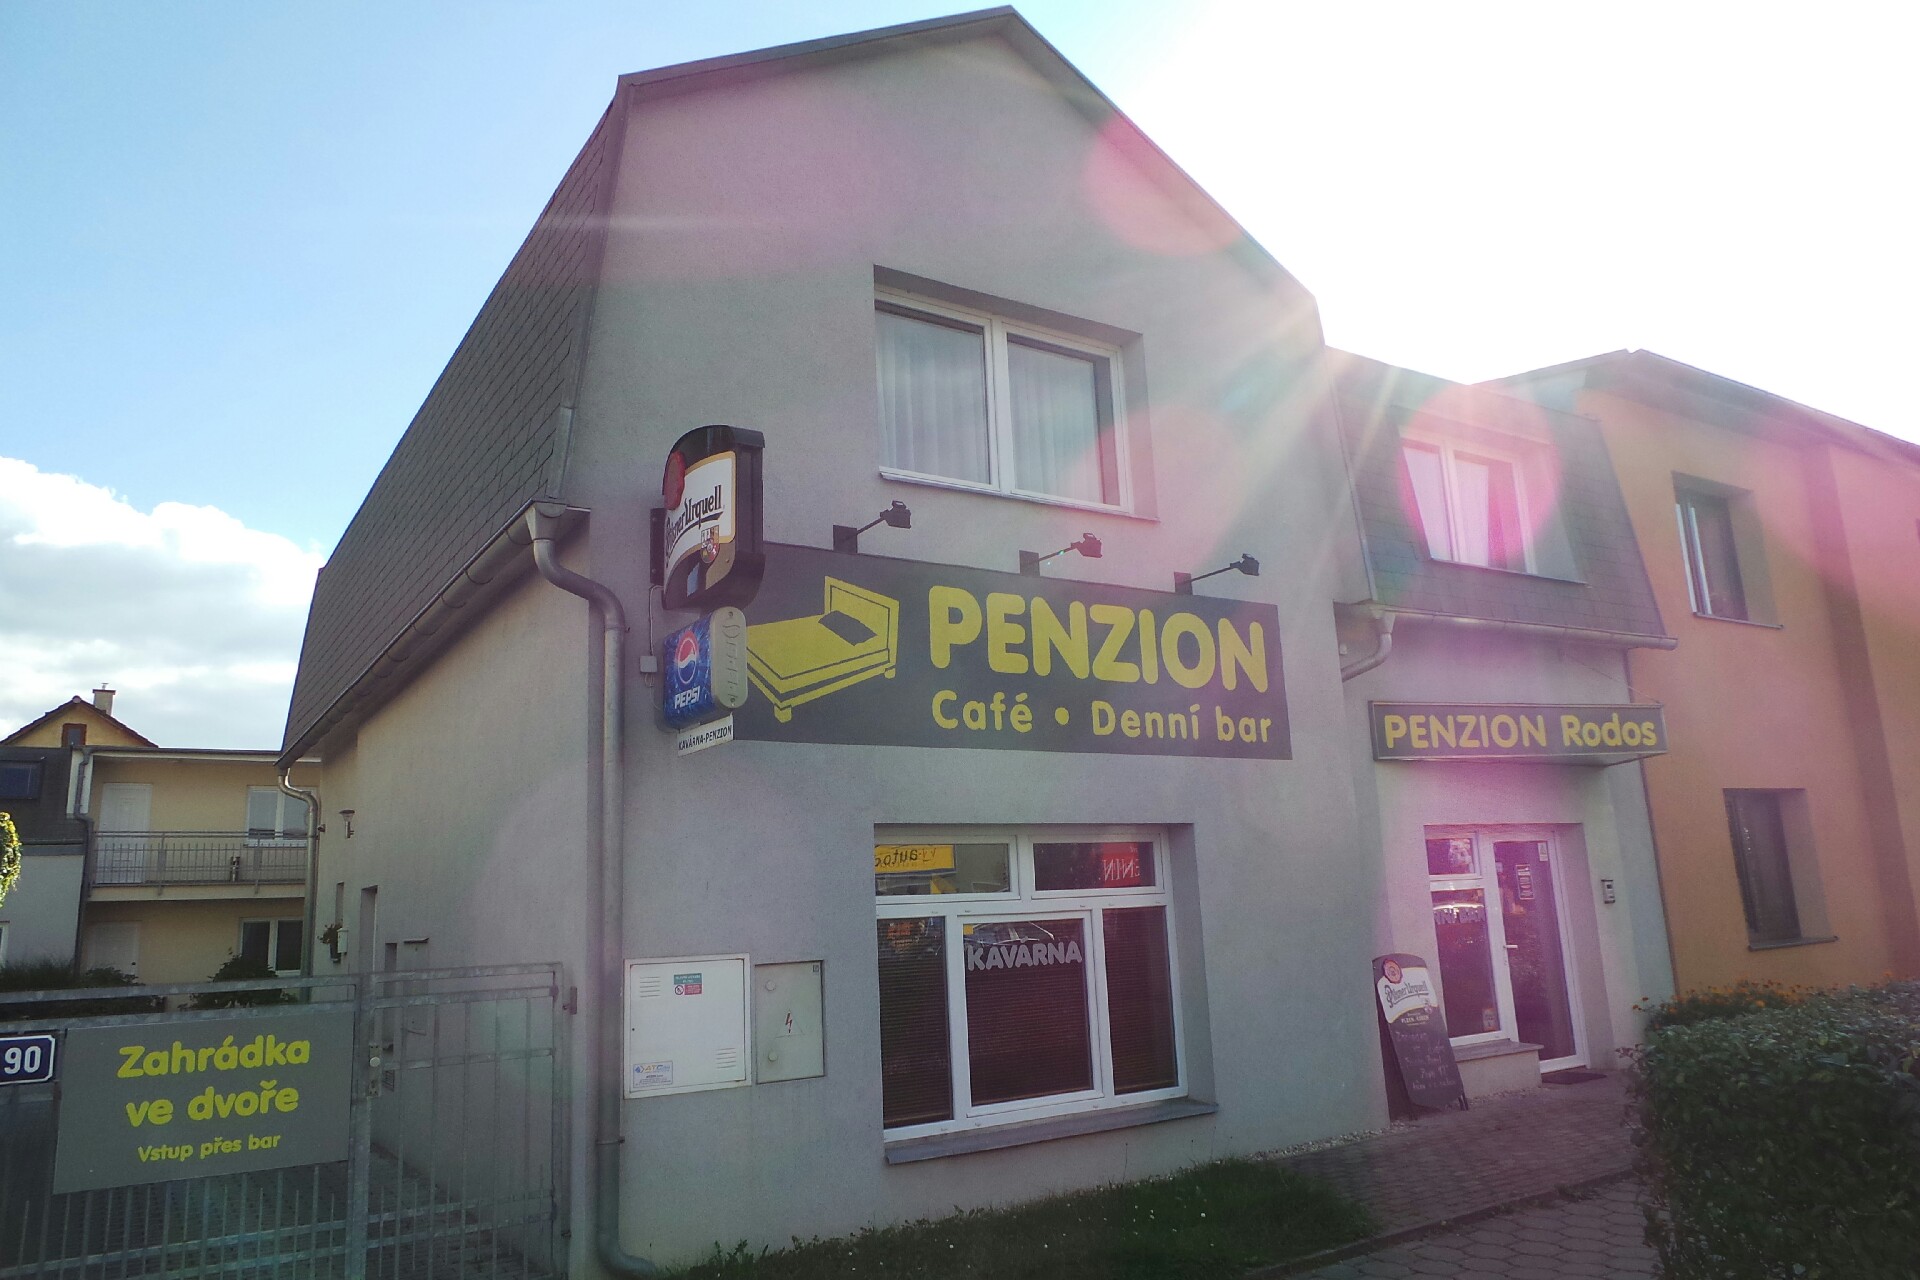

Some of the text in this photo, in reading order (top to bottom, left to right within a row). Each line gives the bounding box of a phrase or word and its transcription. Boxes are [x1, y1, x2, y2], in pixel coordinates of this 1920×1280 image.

[684, 485, 722, 529] Urquell
[928, 585, 1268, 693] PENZION
[674, 685, 701, 709] PEPSI
[932, 689, 1272, 742] Café Denní bar
[1384, 713, 1657, 749] PENZION Rodos
[966, 937, 1082, 971] KAVÁRNA
[4, 1045, 41, 1075] 90
[116, 1034, 311, 1079] Zahrádka
[125, 1080, 299, 1127] ve dvoře
[137, 1133, 281, 1162] Vstup přes bar
